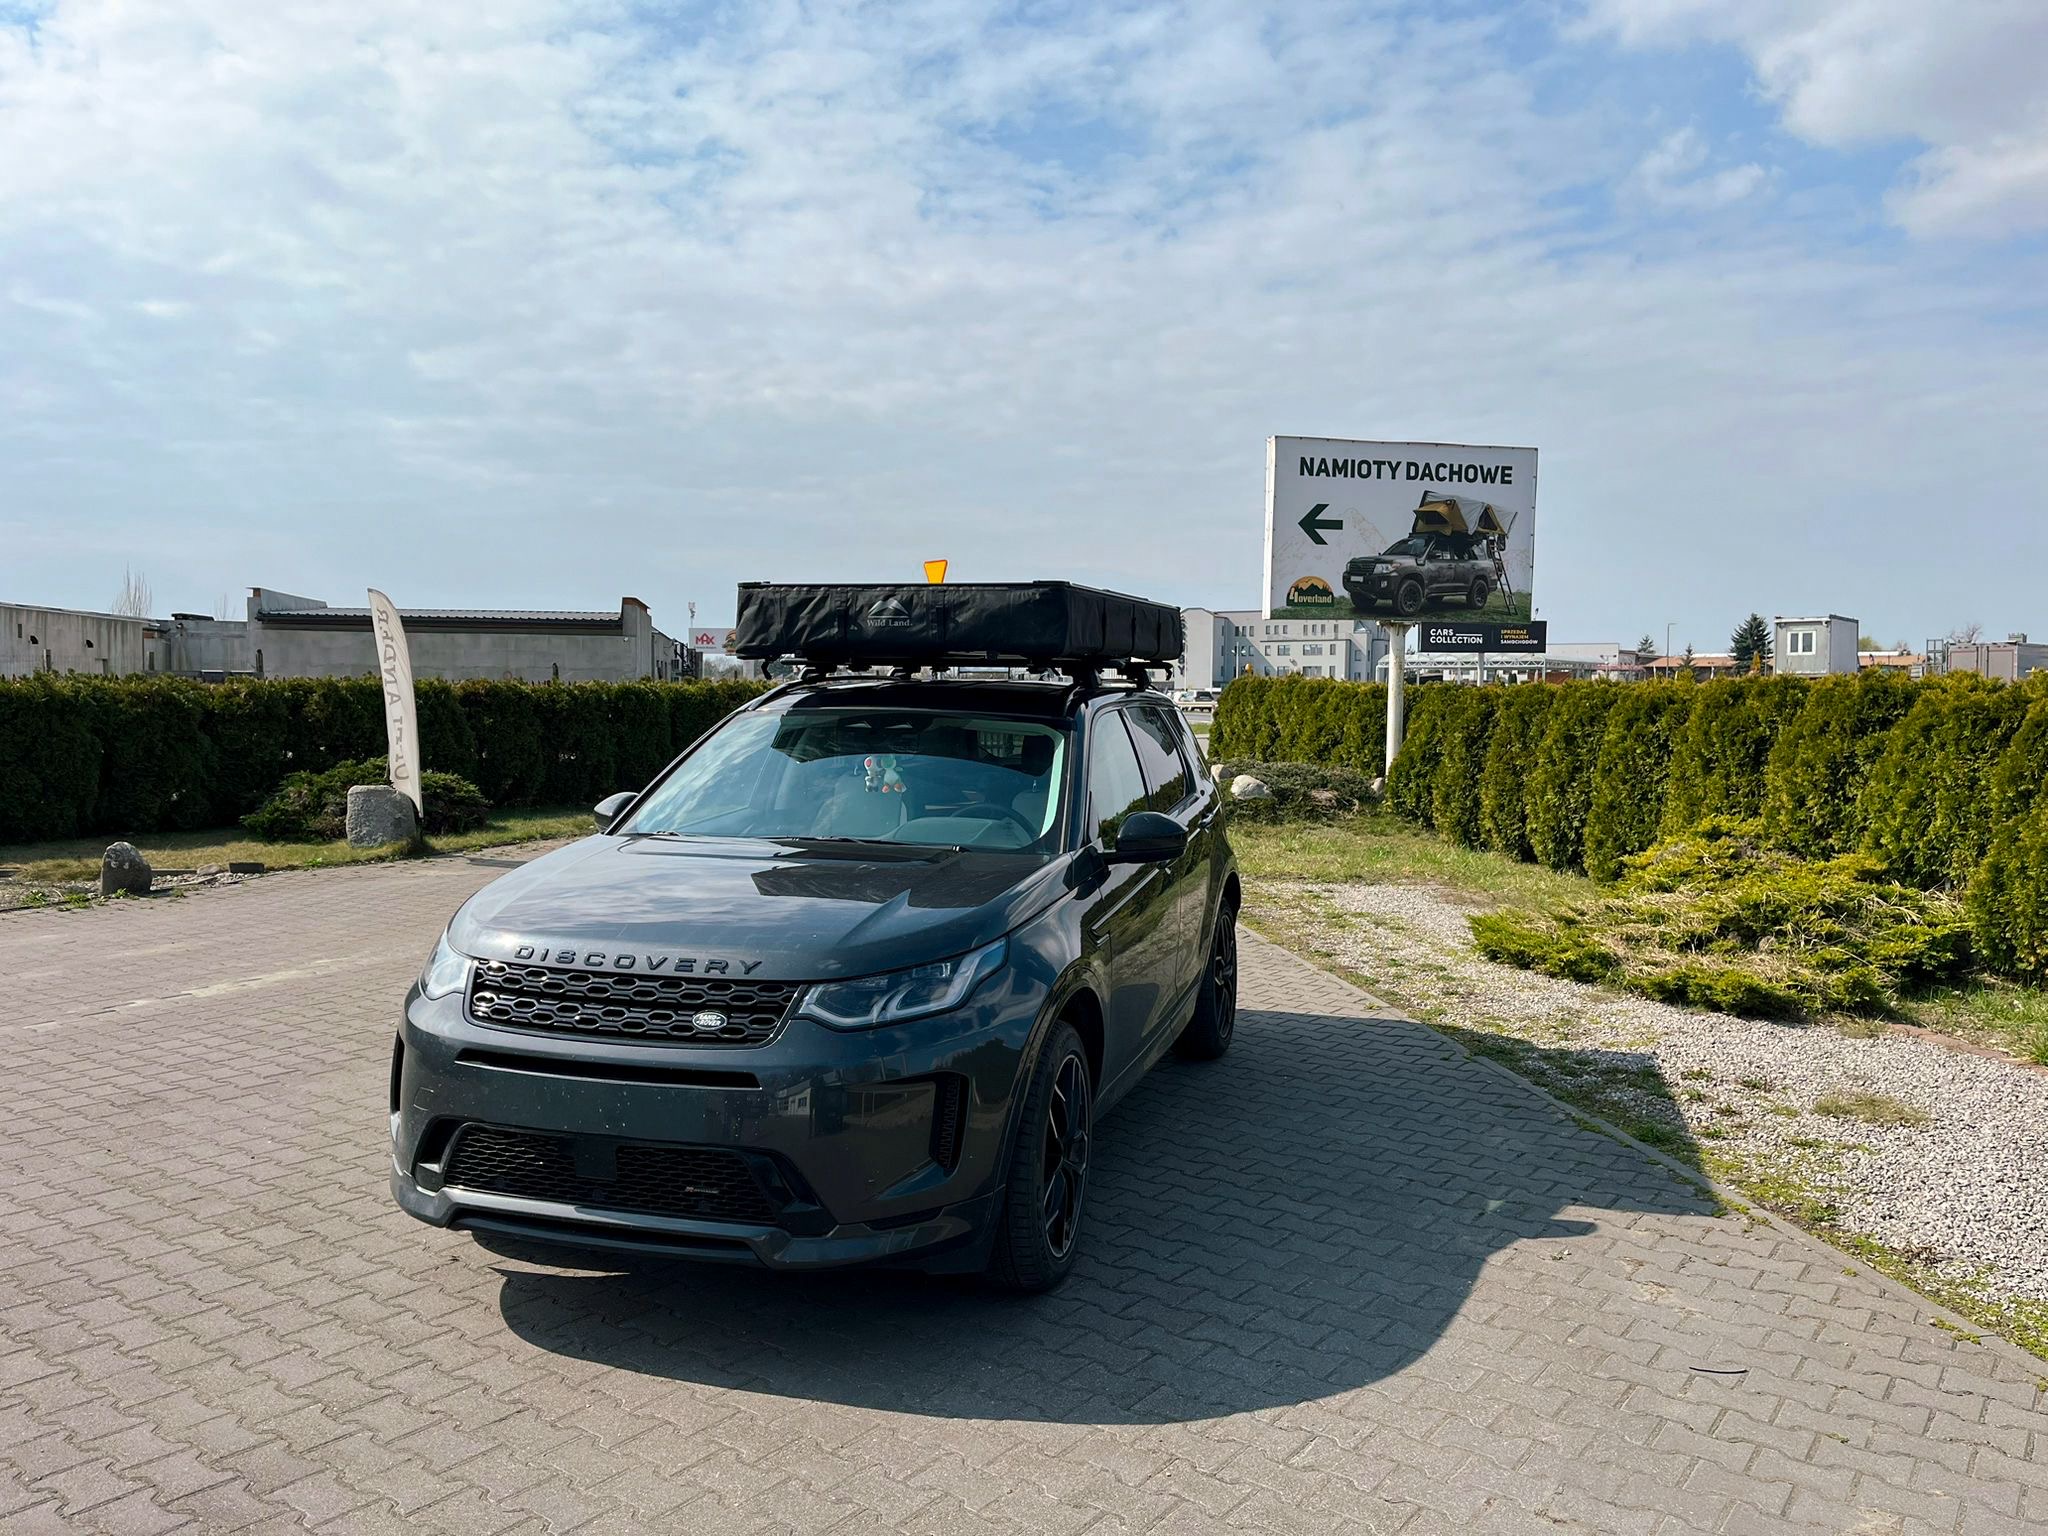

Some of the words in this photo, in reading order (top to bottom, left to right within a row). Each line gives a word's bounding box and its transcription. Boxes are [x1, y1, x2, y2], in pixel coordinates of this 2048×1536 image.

[1300, 457, 1402, 480] NAMIOTY
[1406, 462, 1513, 484] DACHOWE
[867, 619, 886, 627] Wild
[695, 632, 715, 645] MAX
[1430, 636, 1483, 644] COLLECTION
[514, 945, 762, 975] DISCOVERY
